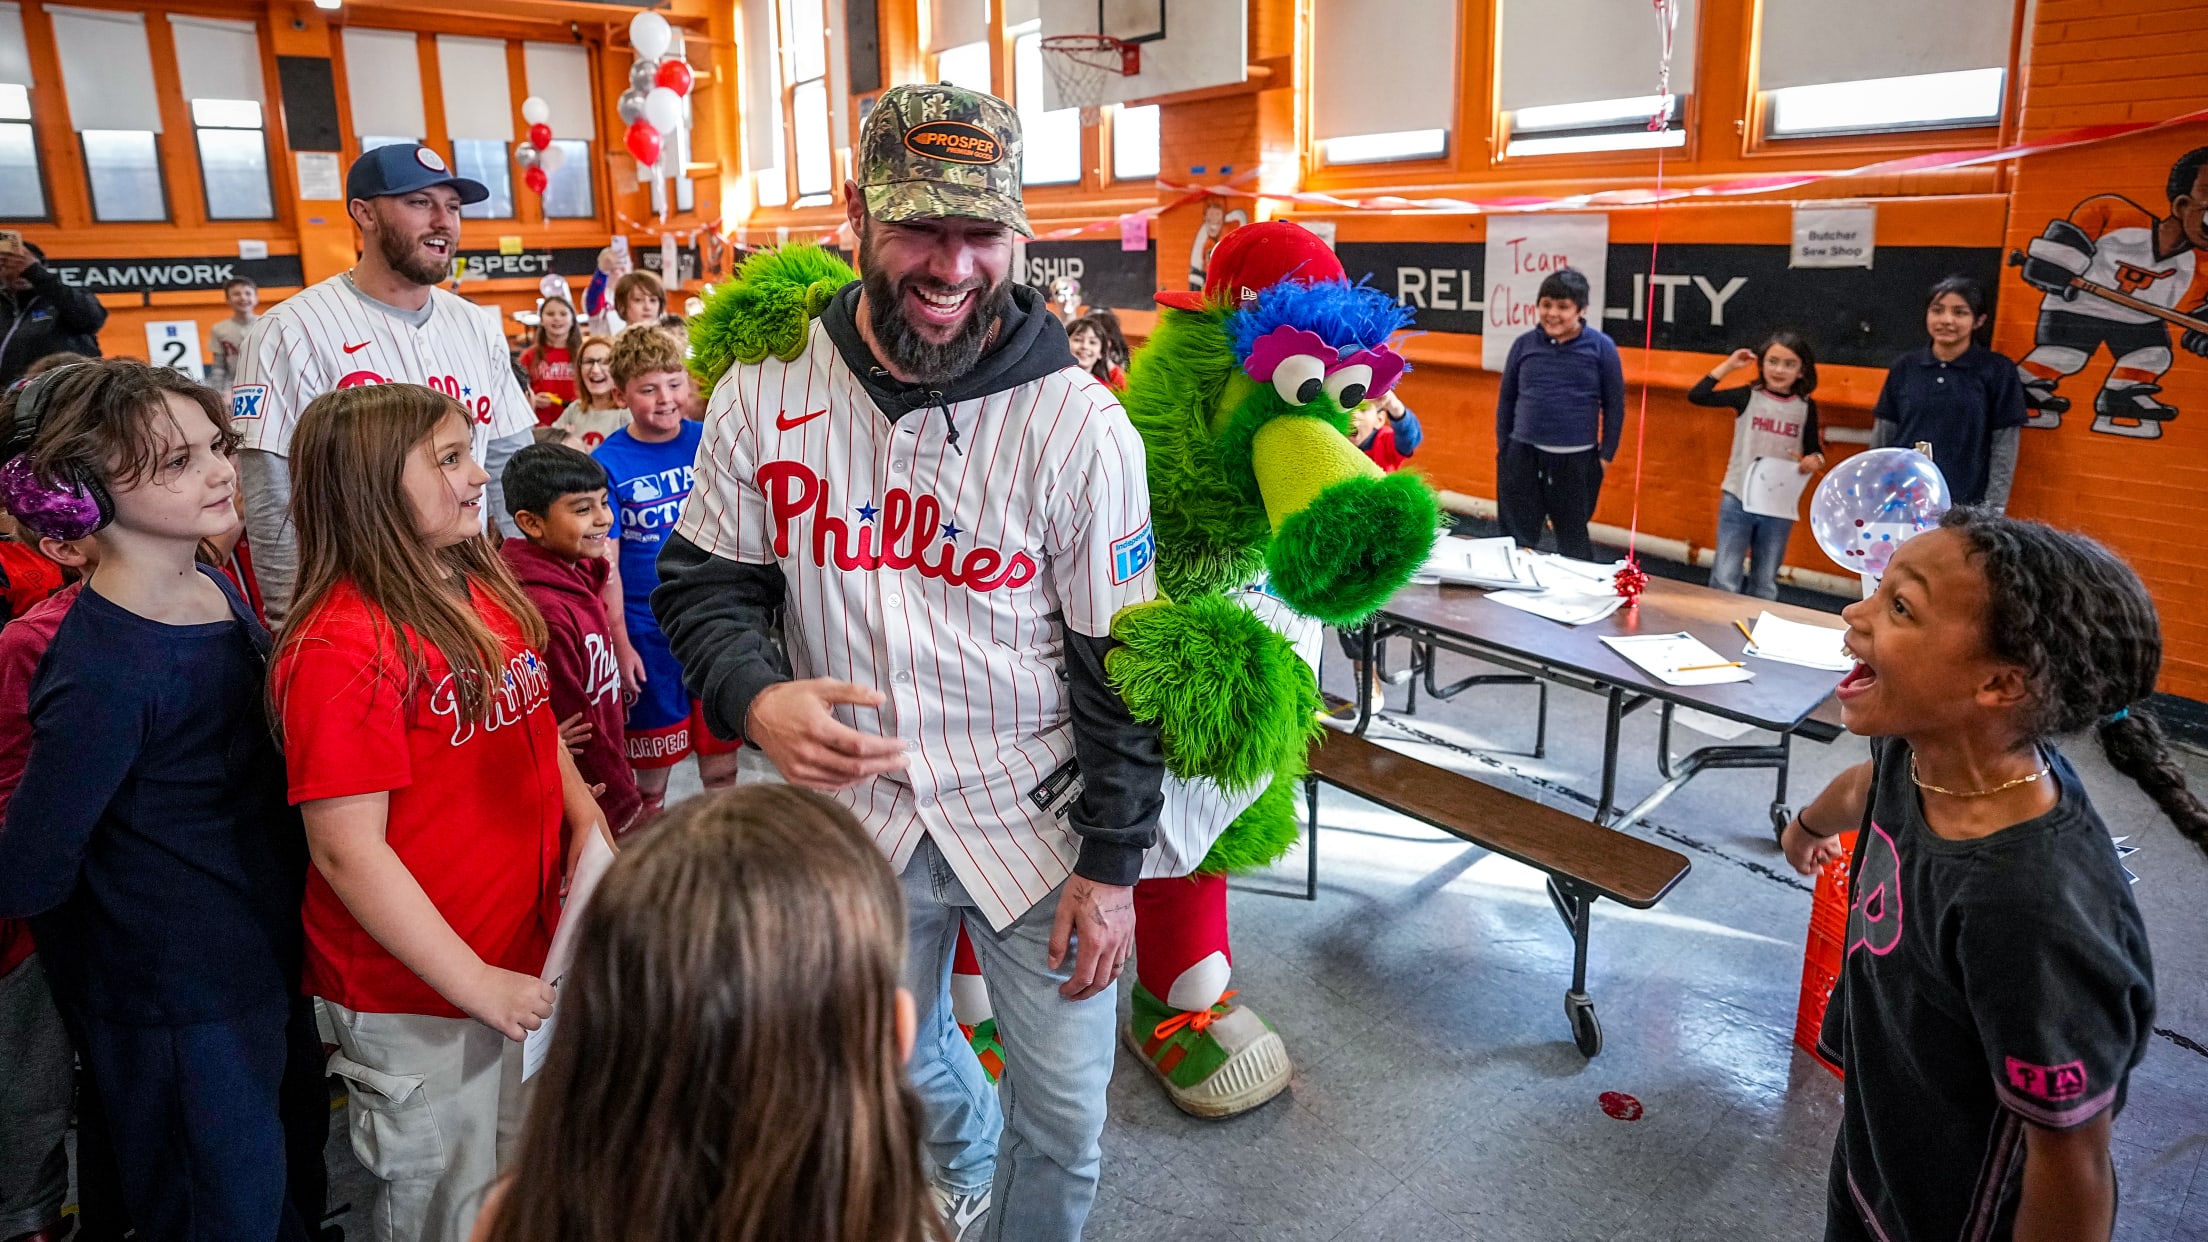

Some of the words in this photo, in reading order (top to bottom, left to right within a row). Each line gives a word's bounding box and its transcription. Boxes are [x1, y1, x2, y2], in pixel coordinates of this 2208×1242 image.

[927, 132, 994, 154] PROSPER
[1808, 230, 1857, 241] Butcher
[451, 254, 553, 275] SPECT
[1506, 237, 1568, 275] Team
[1829, 246, 1863, 258] Shop
[46, 263, 234, 288] EAMWORK
[1490, 284, 1538, 327] Clem
[163, 341, 188, 372] 2
[1752, 416, 1800, 438] PHILLIES
[621, 498, 687, 529] OCT
[757, 460, 1037, 593] Phillies
